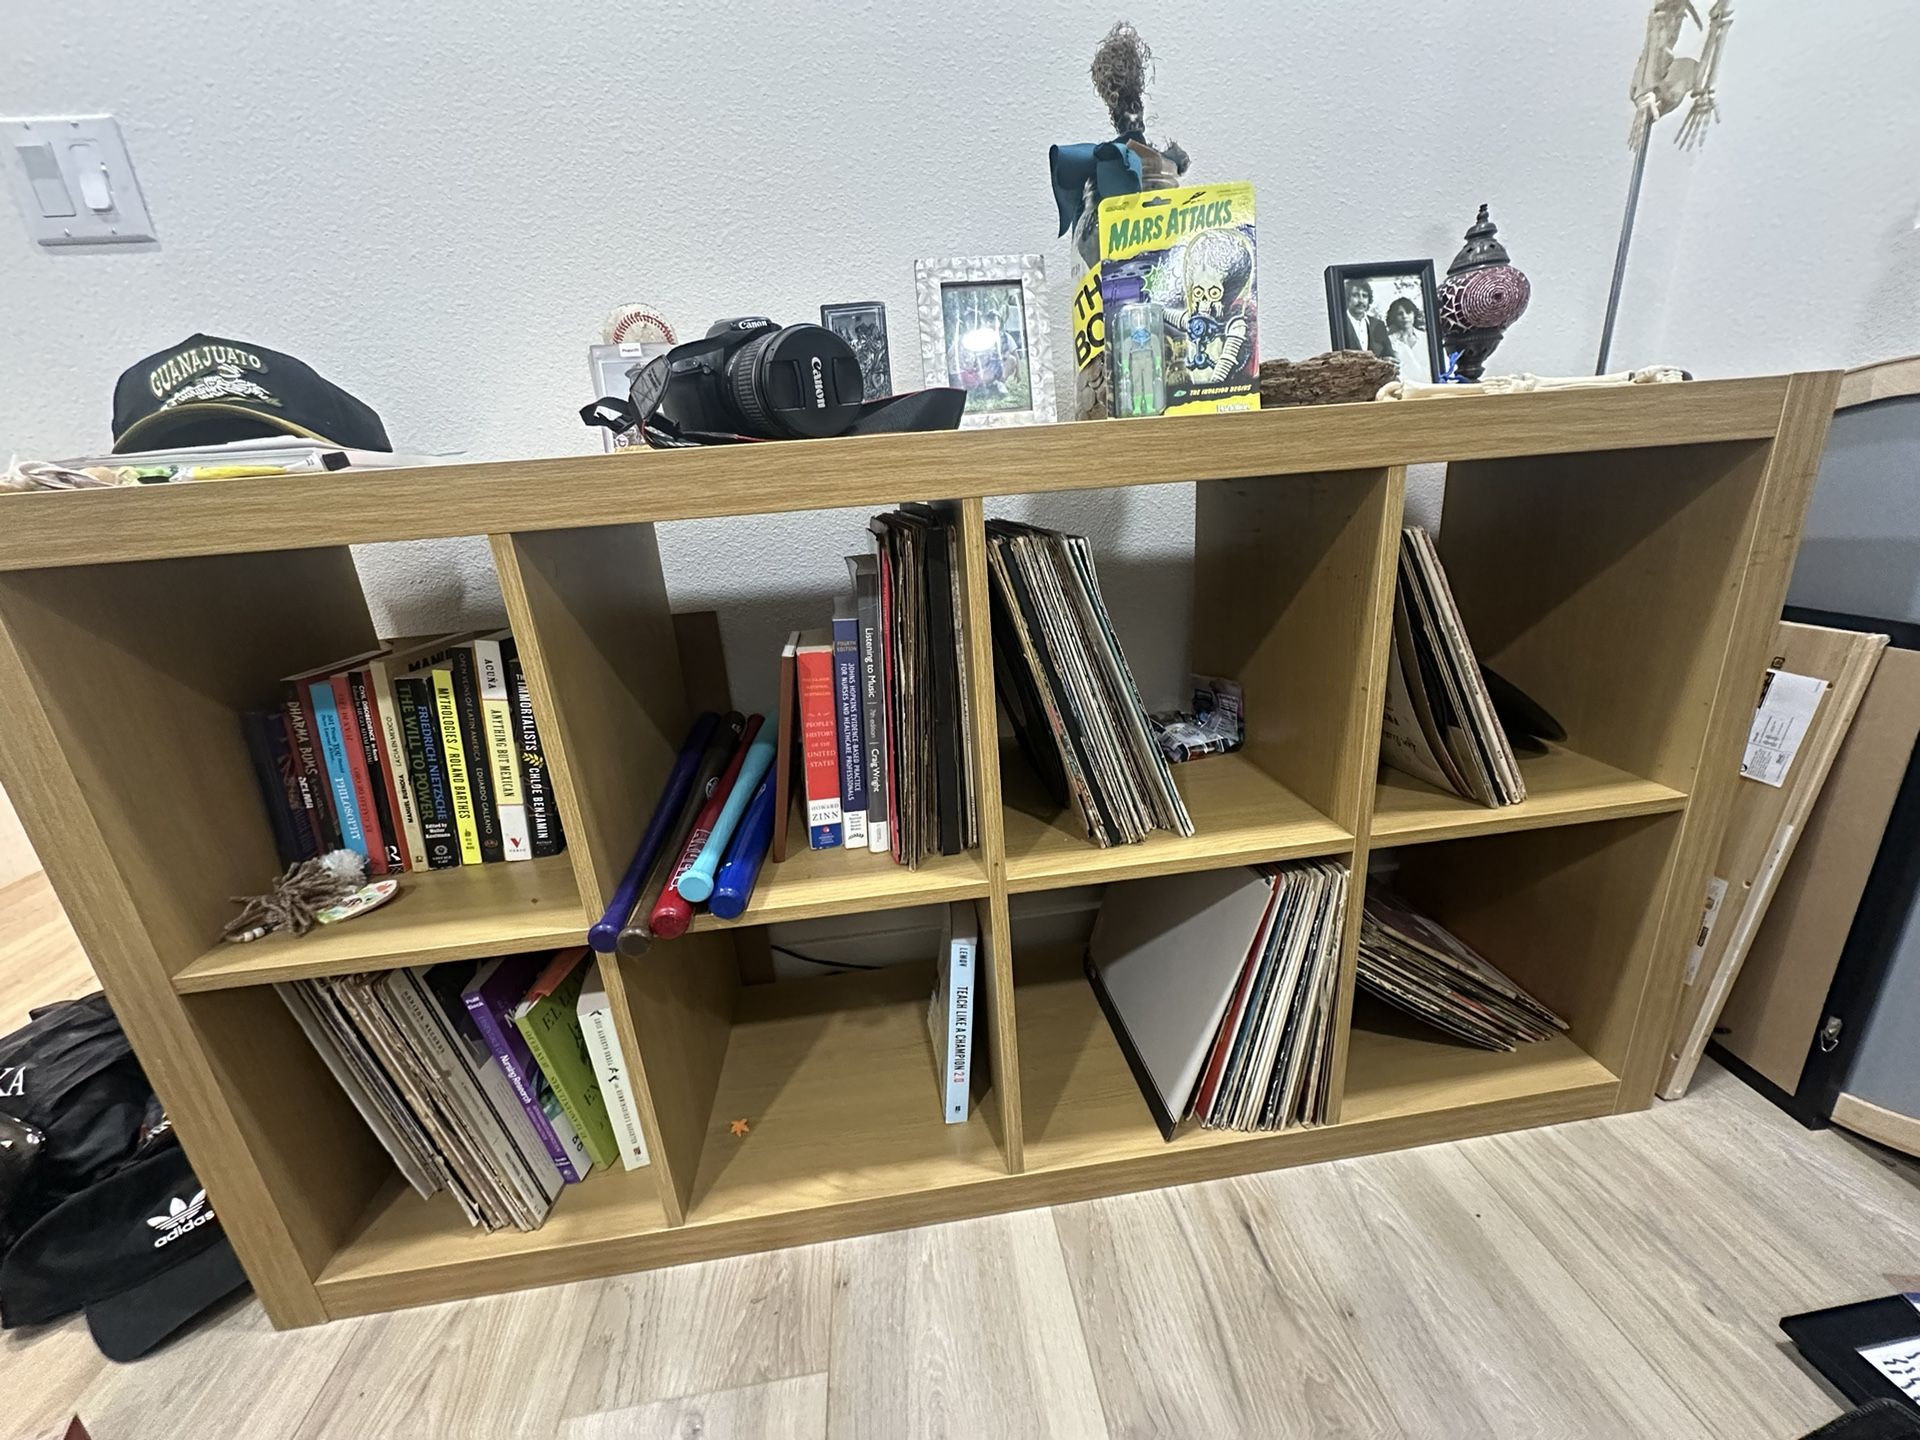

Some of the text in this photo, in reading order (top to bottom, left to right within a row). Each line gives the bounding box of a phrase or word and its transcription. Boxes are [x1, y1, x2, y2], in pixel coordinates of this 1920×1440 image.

[1108, 200, 1232, 257] MARS ATTACKS
[1074, 274, 1103, 320] TH
[738, 319, 768, 330] Canon
[1075, 312, 1105, 367] BO
[149, 344, 262, 396] GUANAJUATO
[810, 356, 827, 409] Canon
[865, 627, 874, 664] Listening
[484, 659, 498, 689] ACUÑA
[867, 665, 875, 673] to
[868, 673, 877, 698] Music
[362, 701, 375, 740] DISOBEDIENCE
[386, 717, 395, 740] MEXICO
[438, 687, 458, 744] MYTHOLOGIES
[467, 708, 476, 729] LATIN
[517, 682, 537, 751] IMMORTALISTS
[806, 720, 834, 728] PEOPLE'S
[287, 701, 317, 777] DHARMA BUMS
[470, 731, 480, 761] AMERICA
[806, 730, 835, 738] HISTORY
[844, 717, 852, 754] HEALTHCARE
[400, 686, 433, 820] THE WILL TO POWER
[418, 705, 447, 820] FRIEDRICH NIETZSCHE
[448, 751, 464, 783] ROLAND
[491, 709, 514, 797] ANYTHING BUT MEXICAN
[807, 750, 836, 758] UNITED
[810, 760, 835, 768] STATES
[870, 749, 879, 768] Craig
[298, 776, 314, 809] SELMA
[476, 768, 486, 800] EDUARDO
[529, 767, 543, 794] CHLOE
[846, 756, 854, 800] PROFESSIONALS
[871, 767, 881, 792] Wright
[335, 777, 361, 841] PHILOSOPHY
[404, 800, 413, 823] MANUEL
[454, 784, 470, 819] BARTHES
[481, 801, 492, 833] GALEANO
[532, 796, 549, 839] BENJAMIN
[811, 803, 840, 811] HOWARD
[812, 811, 839, 822] ZINN
[959, 947, 968, 967] LEMOV
[403, 990, 424, 1021] HORIZON
[956, 986, 968, 1009] TEACH
[955, 1028, 966, 1037] A
[956, 1010, 967, 1026] LIKE
[954, 1035, 966, 1070] CHAMPION
[500, 1054, 517, 1079] Nursing
[512, 1077, 532, 1104] Research
[154, 1210, 215, 1248] adidas
